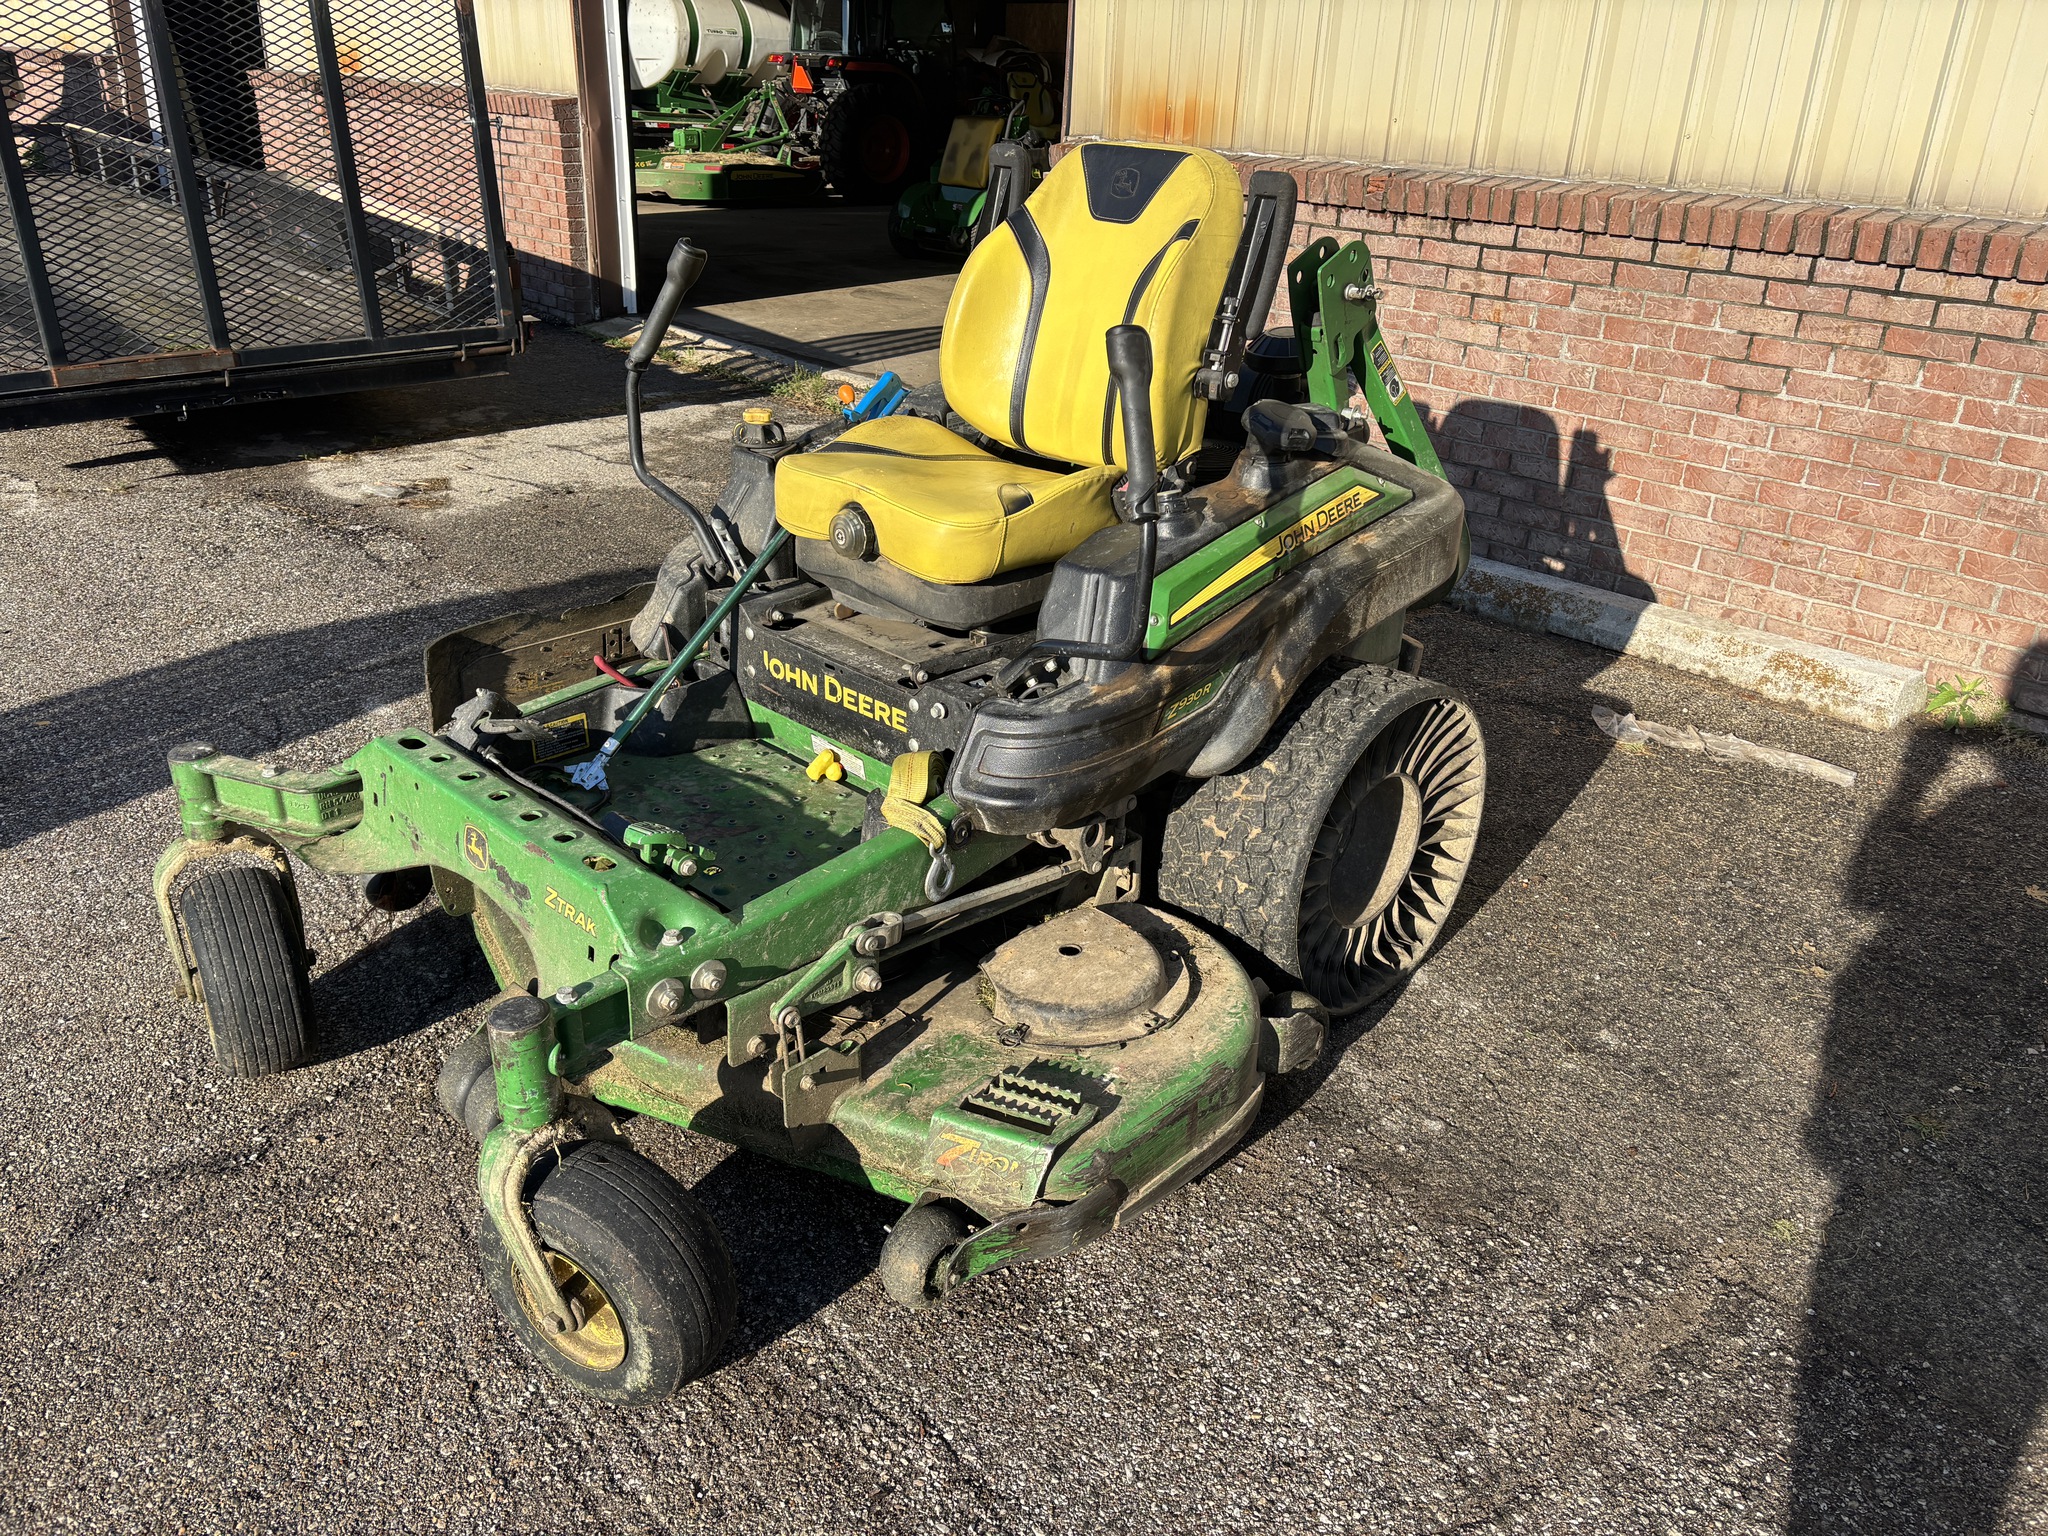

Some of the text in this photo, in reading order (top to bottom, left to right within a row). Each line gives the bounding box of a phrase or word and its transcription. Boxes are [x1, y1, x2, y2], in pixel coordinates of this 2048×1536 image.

[752, 172, 775, 180] DEERE
[1276, 492, 1362, 556] JOHN DEERE
[763, 650, 908, 733] JOHN DEERE
[1167, 682, 1212, 720] Z930R
